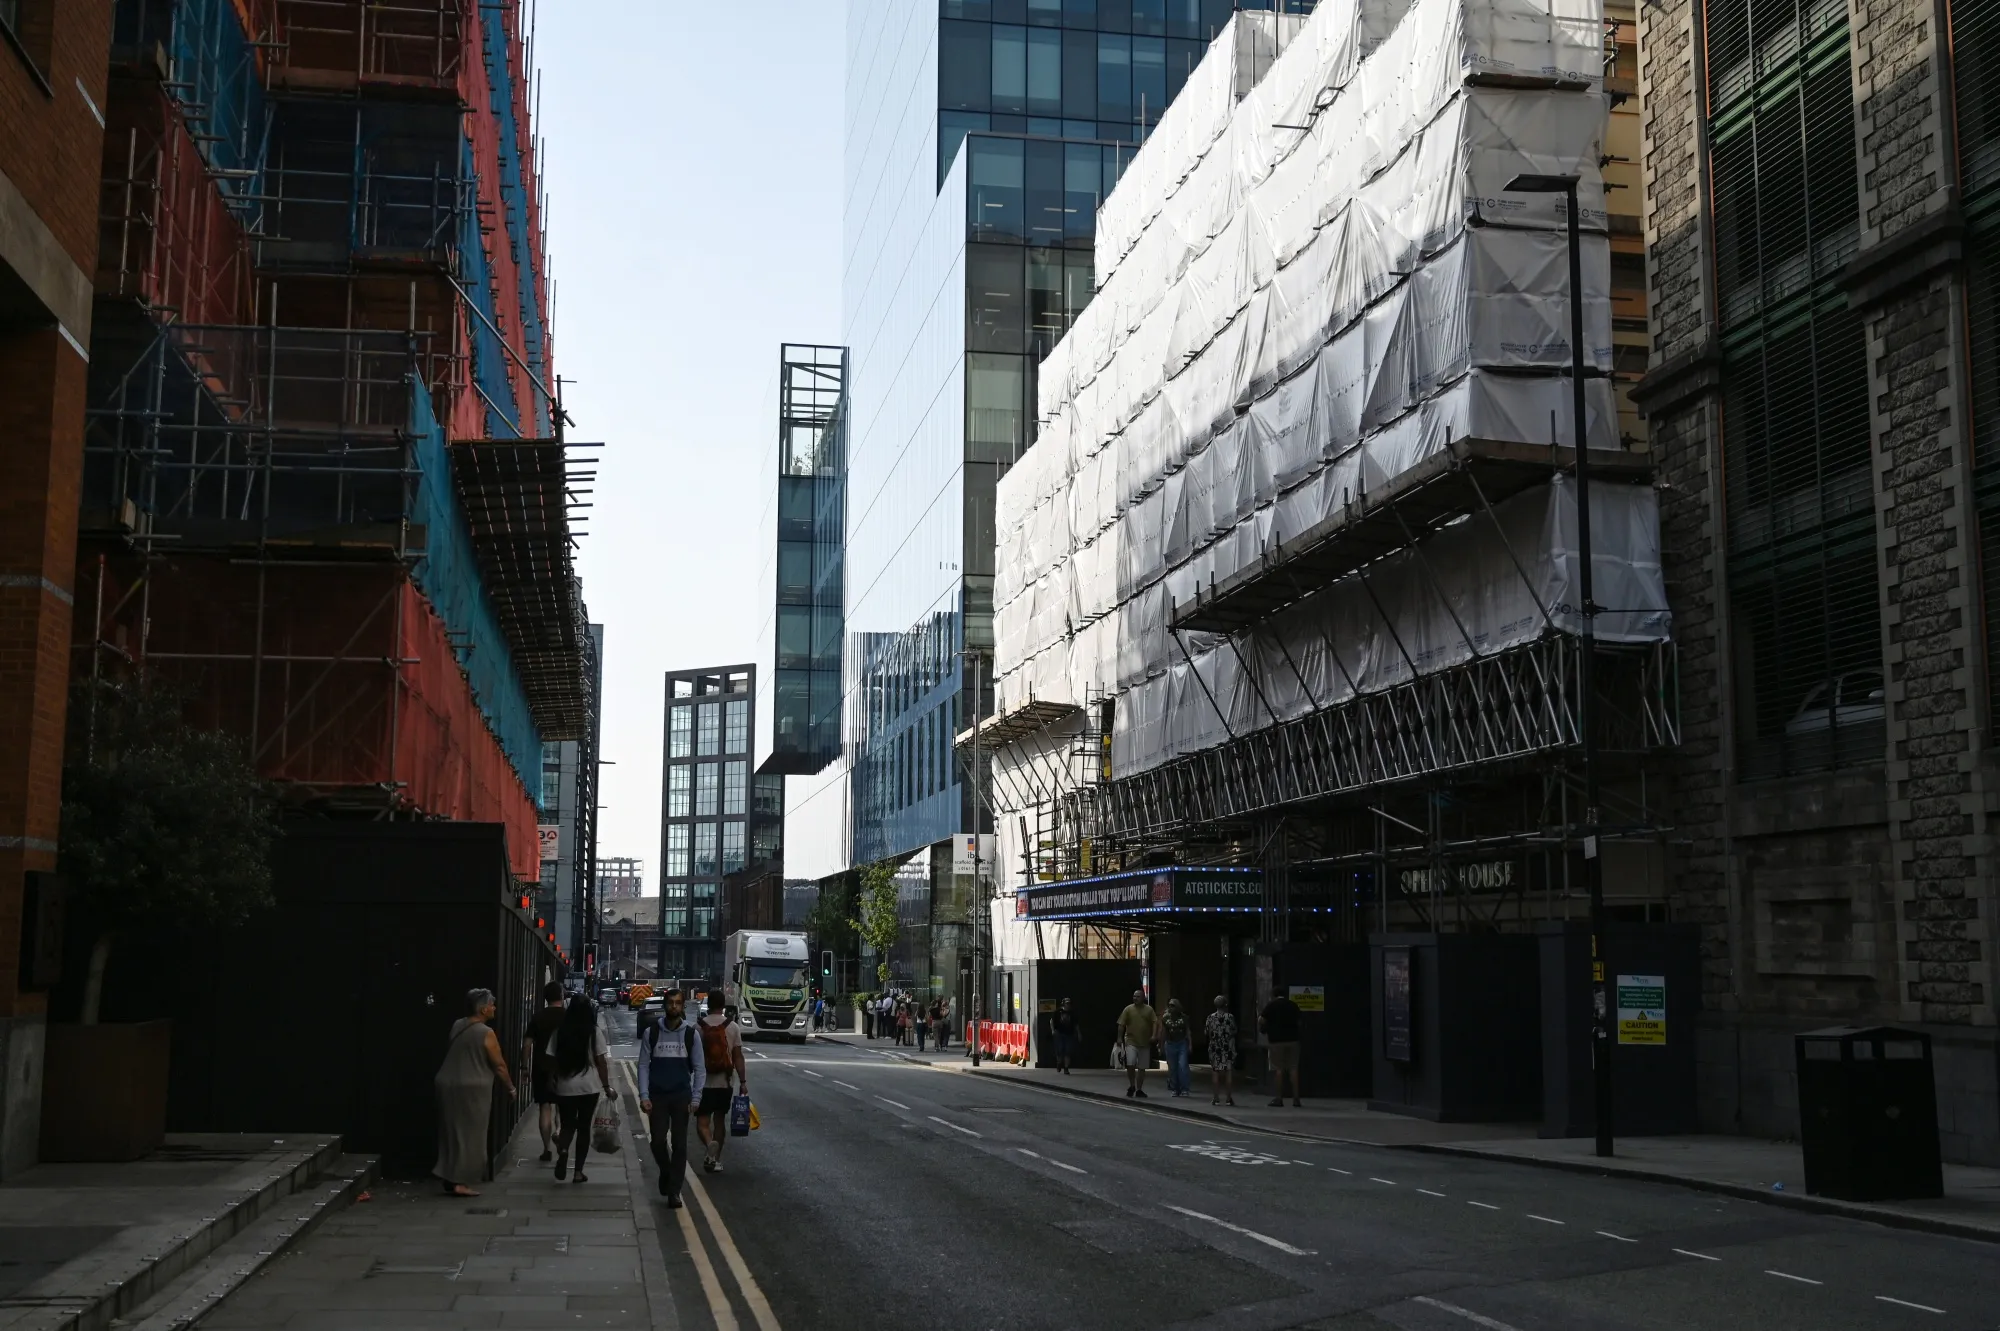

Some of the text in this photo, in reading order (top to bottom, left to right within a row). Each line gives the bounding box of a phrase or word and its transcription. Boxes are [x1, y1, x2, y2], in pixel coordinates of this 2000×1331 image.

[1459, 861, 1517, 888] HOUSE
[1184, 881, 1262, 895] ATGTICKETS.CO
[1053, 894, 1064, 909] YOUR
[1081, 889, 1098, 907] DOLLAR
[1098, 888, 1109, 904] THAT
[1127, 884, 1140, 901] LOVE
[748, 989, 766, 997] 100%
[1626, 1021, 1659, 1029] CAUTION
